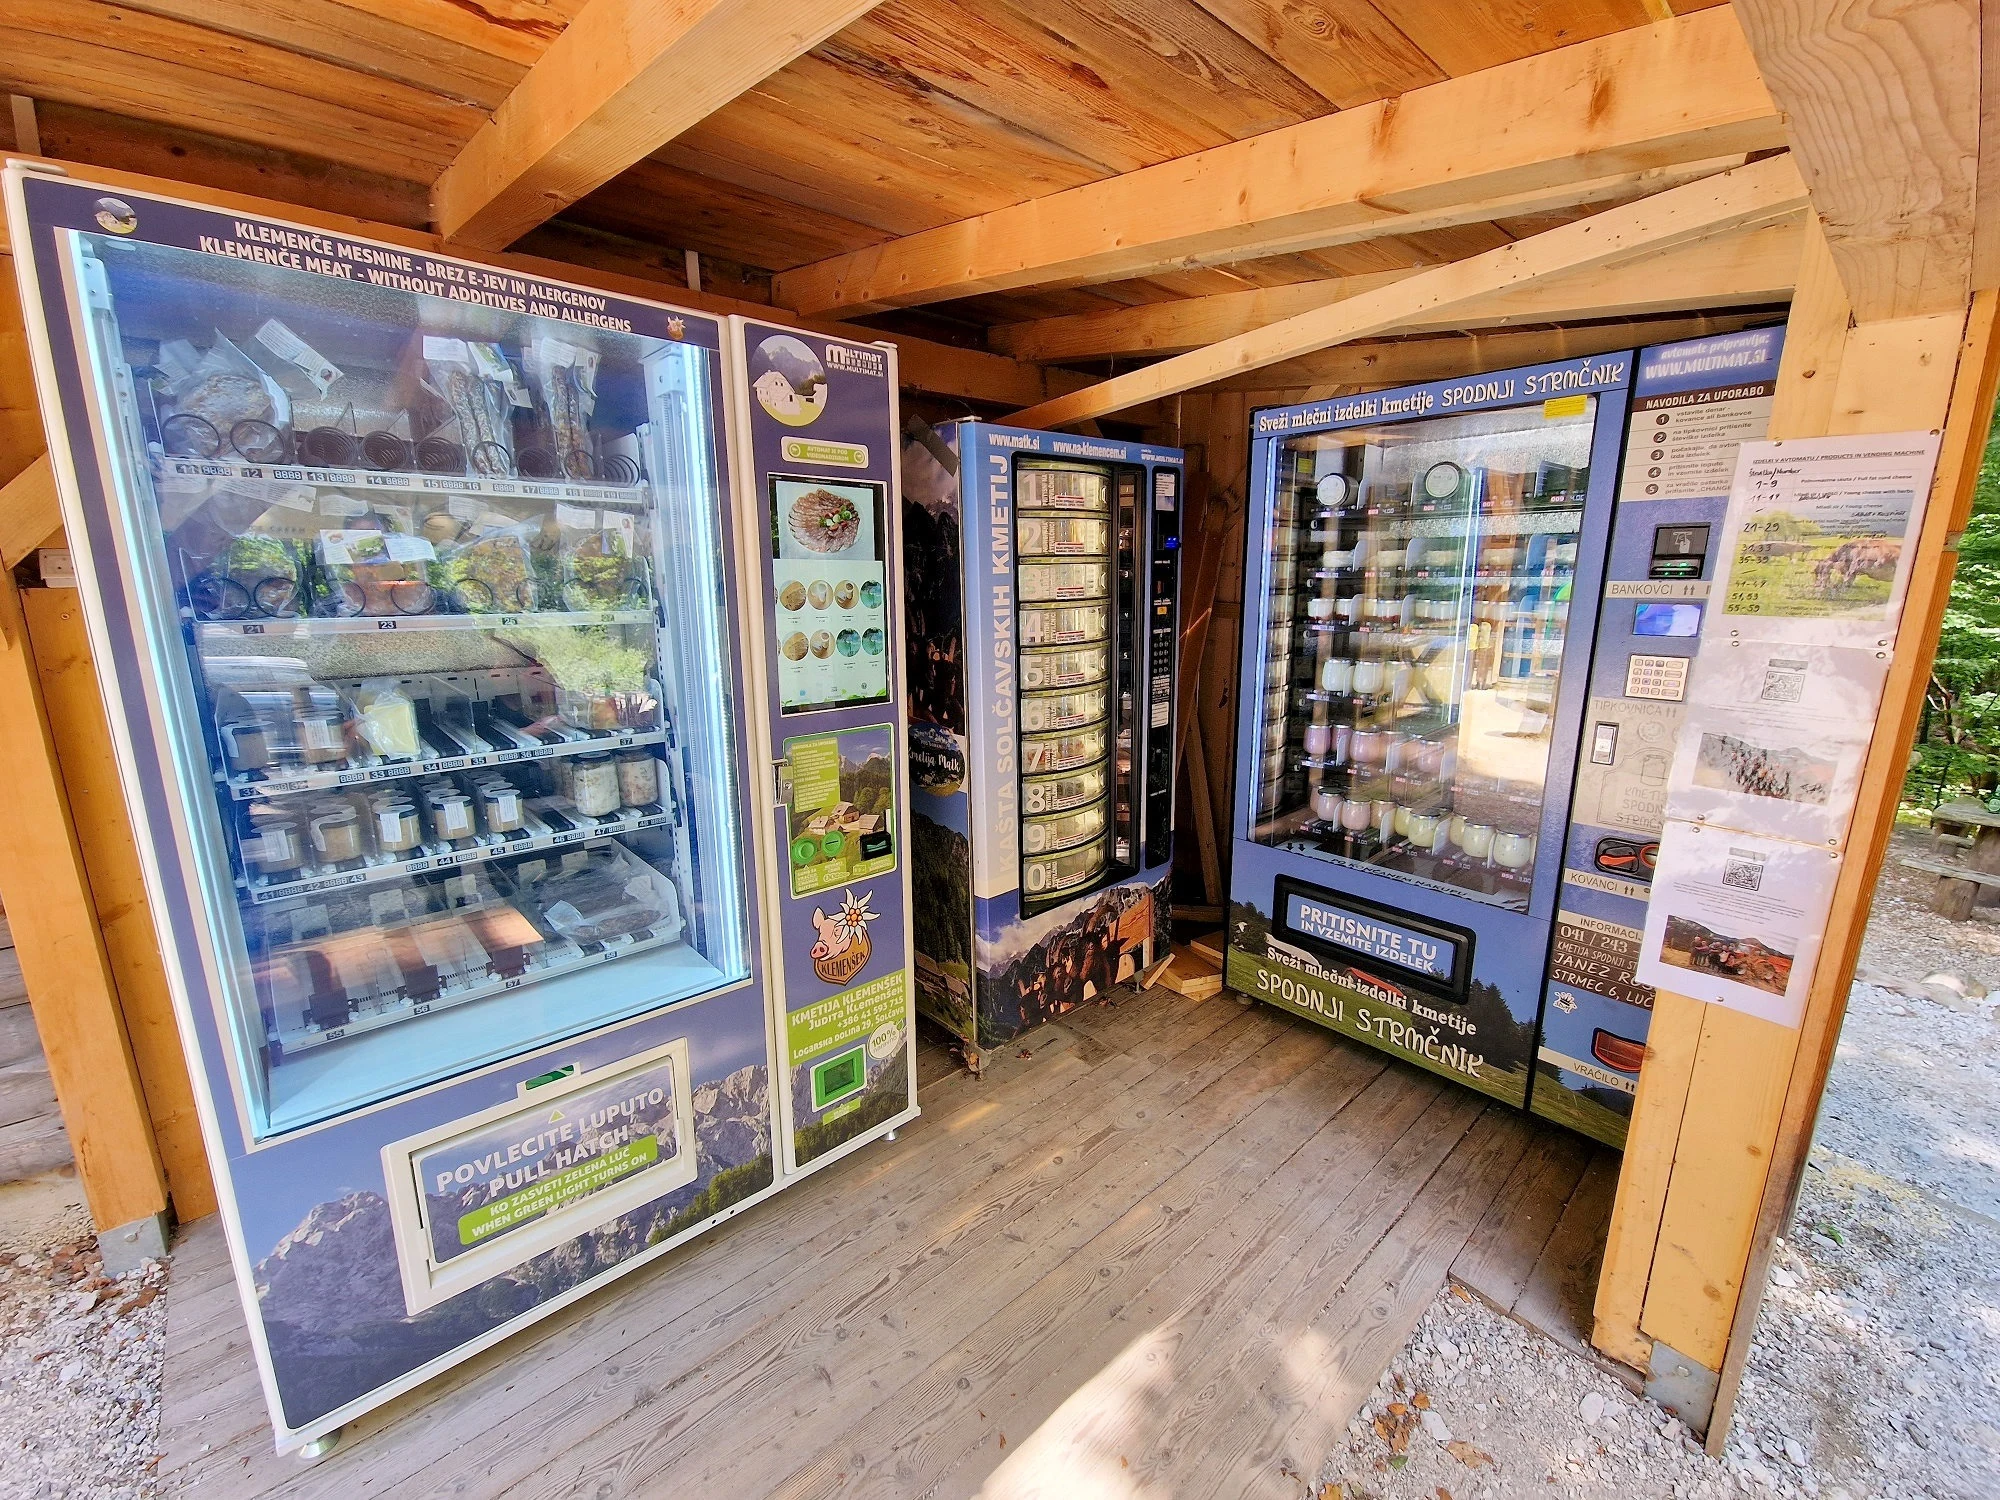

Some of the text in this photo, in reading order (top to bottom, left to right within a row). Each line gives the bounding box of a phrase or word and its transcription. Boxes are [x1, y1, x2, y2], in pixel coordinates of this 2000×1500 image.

[234, 220, 606, 312] KLEMENČE MESNINE BREZ E-JEV IN ALERGENOV
[199, 235, 632, 333] KLEMENČE MEAT WITHOUT ADDITIVES AND ALLERGENS
[1645, 348, 1766, 380] WWW.MULTIMAT.SI
[1259, 358, 1625, 433] Sveži mlečni izdelki kmetije SPODNJI STRMČNIK
[1645, 385, 1765, 410] NAVODILA ZA UPORABO
[244, 468, 536, 494] 12 13 14 15 16 17
[1023, 473, 1041, 507] 1
[1022, 523, 1042, 554] 2
[1023, 567, 1042, 599] 3
[1611, 583, 1674, 596] BANKOVCI
[381, 620, 395, 630] 23
[1023, 612, 1044, 643] 4
[990, 454, 1015, 872] KAŠTA SOLČAVSKIH KMETIJ
[1025, 656, 1044, 688] 5
[1025, 701, 1044, 731] 6
[1593, 699, 1662, 717] TIPKOVNICA
[372, 770, 386, 779] 33
[424, 763, 438, 772] 34
[472, 757, 486, 765] 35
[520, 751, 532, 760] 36
[908, 747, 935, 768] metija
[1024, 742, 1044, 773] 7
[1027, 784, 1045, 813] 8
[1622, 798, 1663, 815] SPODN
[1027, 824, 1046, 853] 9
[260, 828, 606, 900] 41 42 43 44 45 46 47
[1569, 873, 1618, 891] KOVANCI
[1300, 904, 1438, 961] PRITISNITE TU
[1560, 925, 1586, 942] 041
[1600, 936, 1628, 954] 243
[1580, 917, 1641, 940] INFORMACI
[1300, 919, 1434, 973] IN VZEMITE IZDELEK
[1557, 941, 1626, 968] KMETIJA SPODNJI
[821, 951, 866, 978] KLEMENŠEK
[1554, 952, 1611, 978] JANEZ
[791, 972, 903, 1026] KMETIJA KLEMENŠEK
[1266, 945, 1478, 1038] Sveži mlečni izdelki kmetije
[1552, 968, 1605, 992] STRMEC
[1625, 990, 1656, 1008] LUČ
[416, 1006, 429, 1014] 56
[837, 995, 904, 1029] +386 41 593 715
[1256, 968, 1485, 1079] SPODNJI STRMČNIK
[1573, 1061, 1620, 1087] VRAČILO
[435, 1087, 665, 1194] POVLECITE LUPUTO
[489, 1124, 630, 1199] PULL HATCH
[471, 1152, 648, 1238] WHEN GREEN LIGHT TURNS ON
[489, 1145, 631, 1218] KO ZASVETI ZELENA LUČ
